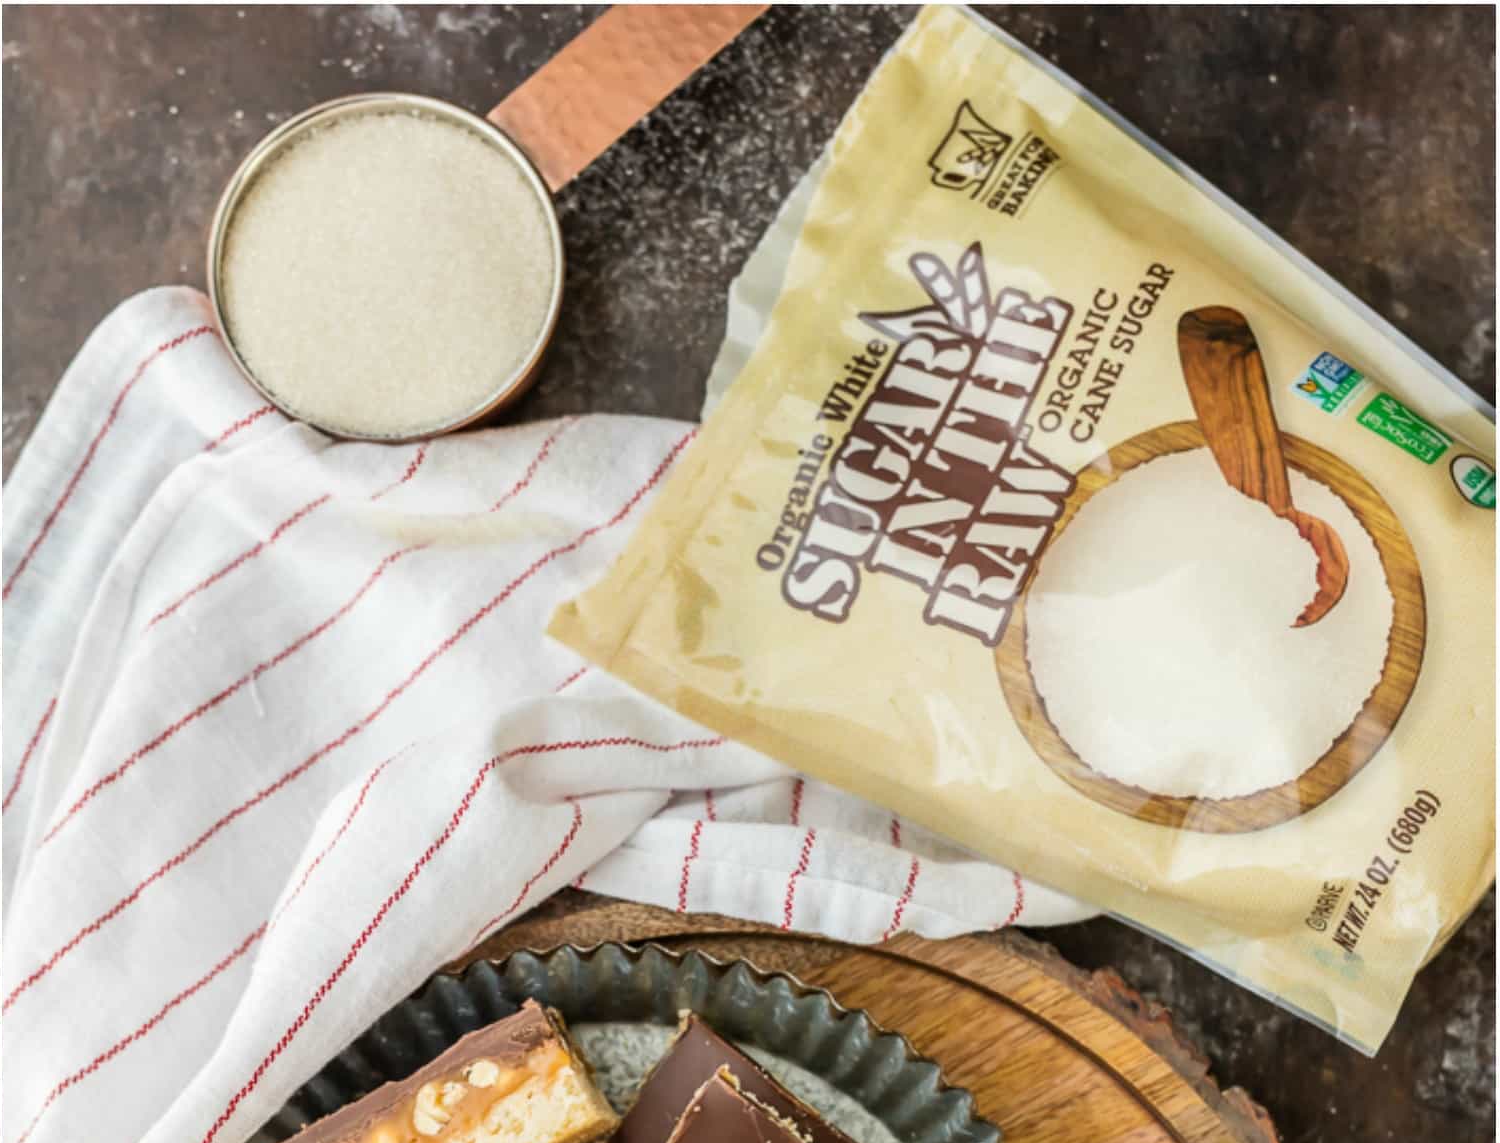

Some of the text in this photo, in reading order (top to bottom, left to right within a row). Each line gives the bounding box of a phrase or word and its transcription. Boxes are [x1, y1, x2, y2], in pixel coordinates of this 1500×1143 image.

[987, 136, 1045, 210] GREAT FOR
[999, 146, 1061, 217] BAKING
[868, 294, 1069, 587] IN THE
[1038, 287, 1119, 434] ORGANIC
[1071, 262, 1175, 442] CANE SUGAR
[755, 338, 889, 572] Organic White
[786, 331, 972, 619] SUGAR
[929, 440, 1071, 642] RAW
[1332, 789, 1442, 953] NET WT. 24 OZ. (680g)
